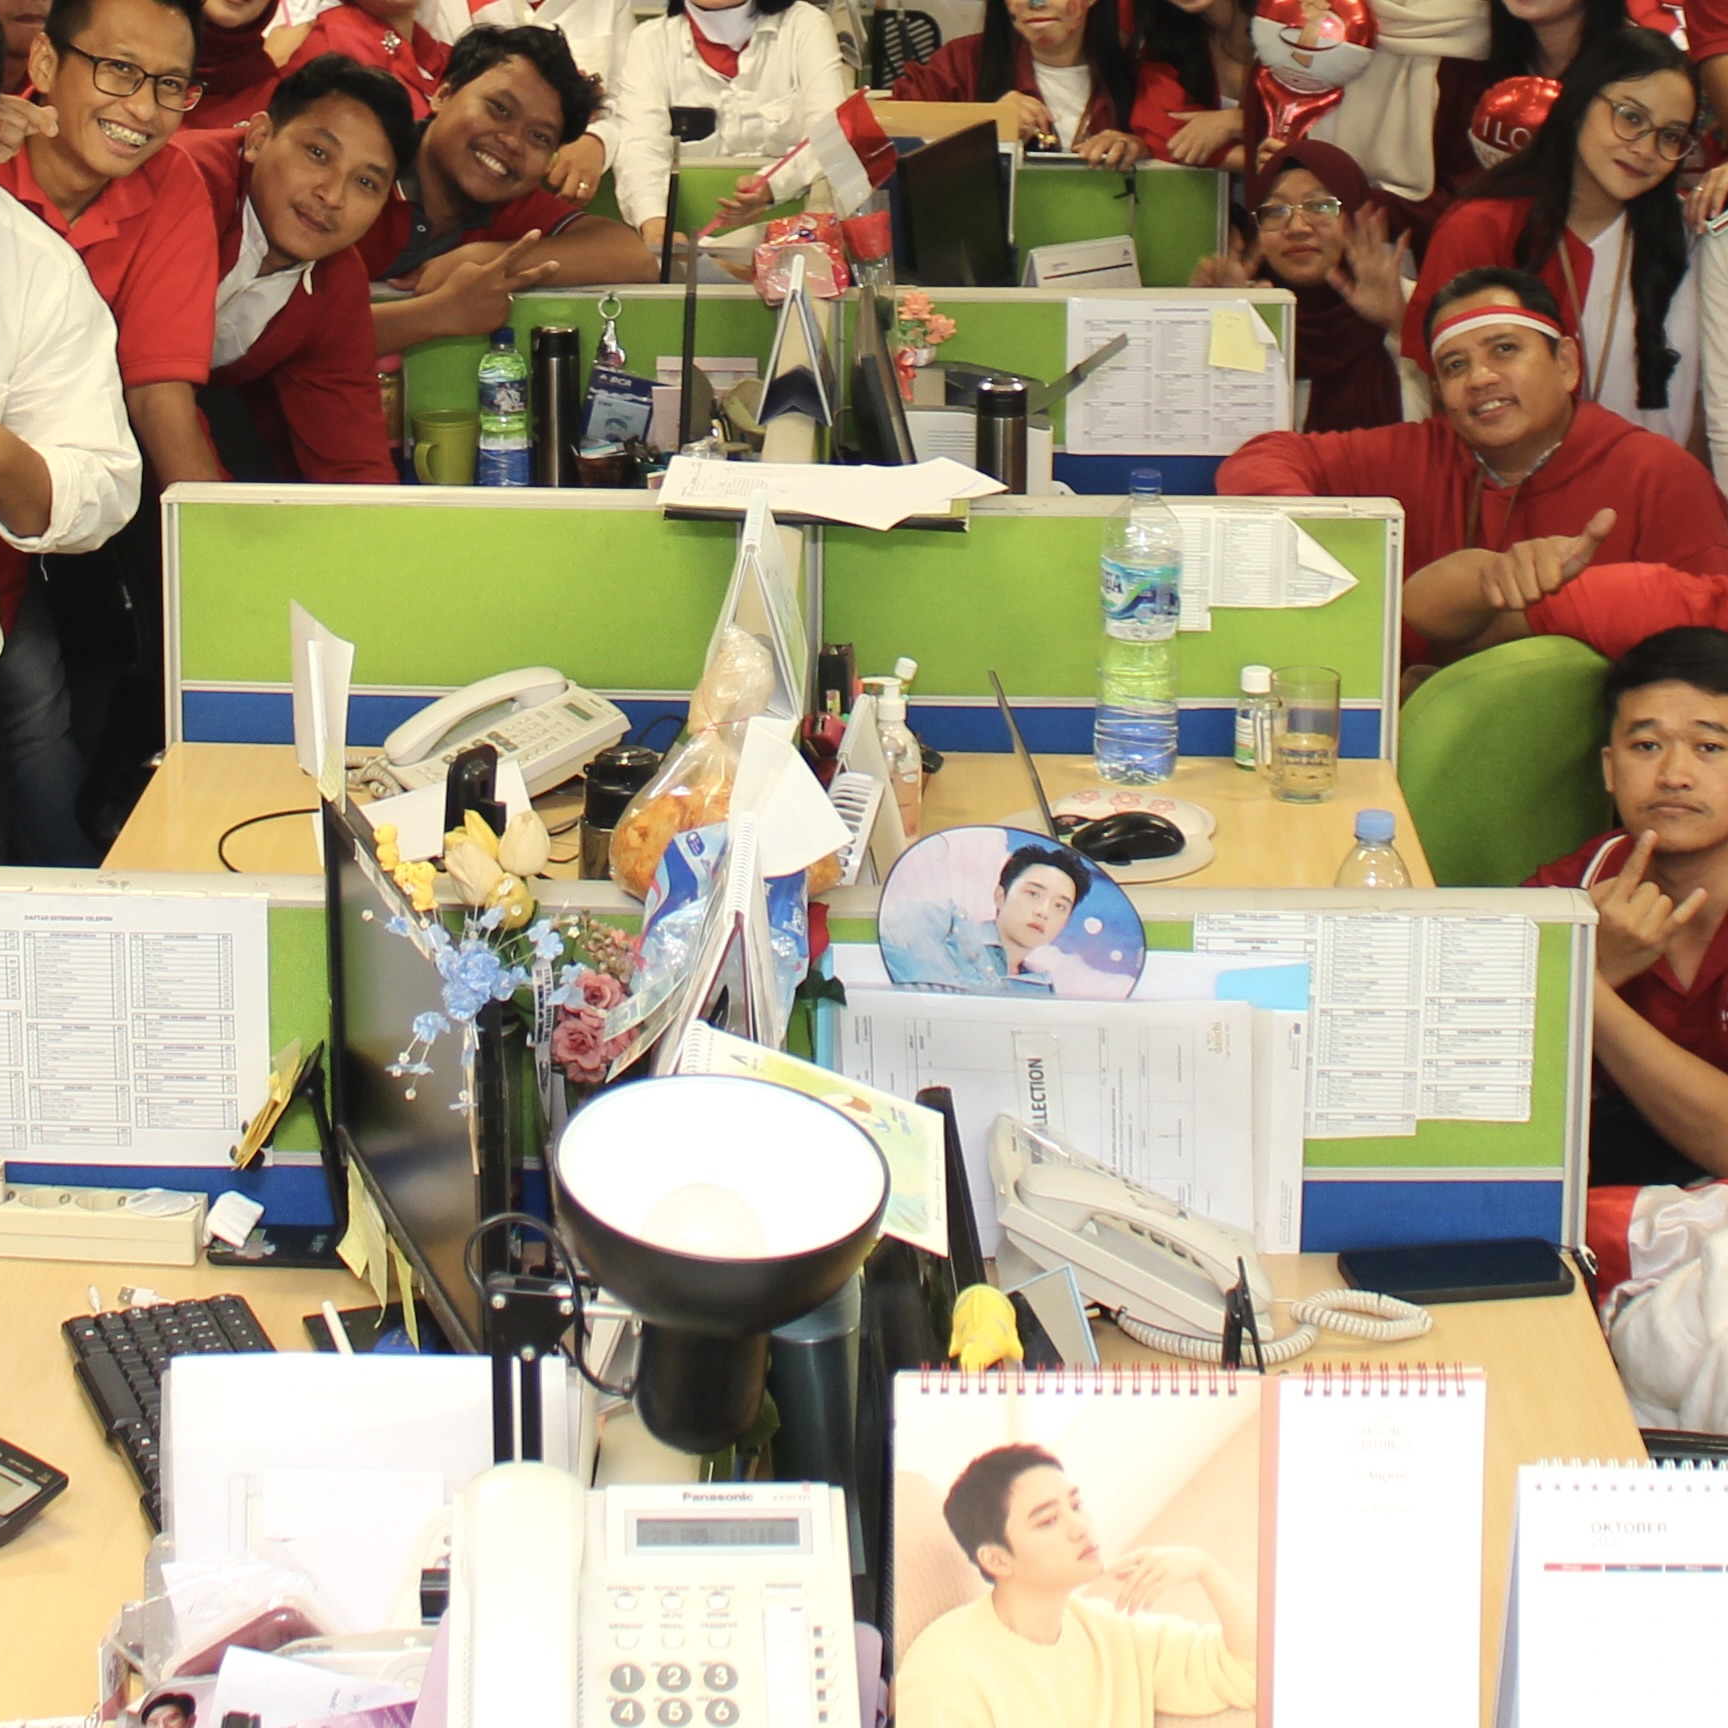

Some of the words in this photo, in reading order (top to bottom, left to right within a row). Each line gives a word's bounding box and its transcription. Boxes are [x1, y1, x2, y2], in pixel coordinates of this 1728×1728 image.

[1495, 121, 1532, 150] LO
[1027, 1057, 1048, 1129] LLECTION
[682, 1491, 754, 1503] Panasonic
[1591, 1521, 1668, 1534] OKTOBER
[622, 1667, 632, 1687] 1
[667, 1667, 682, 1686] 2
[715, 1667, 728, 1686] 3
[619, 1702, 634, 1722] 4
[668, 1702, 683, 1721] 5
[715, 1702, 729, 1722] 6
